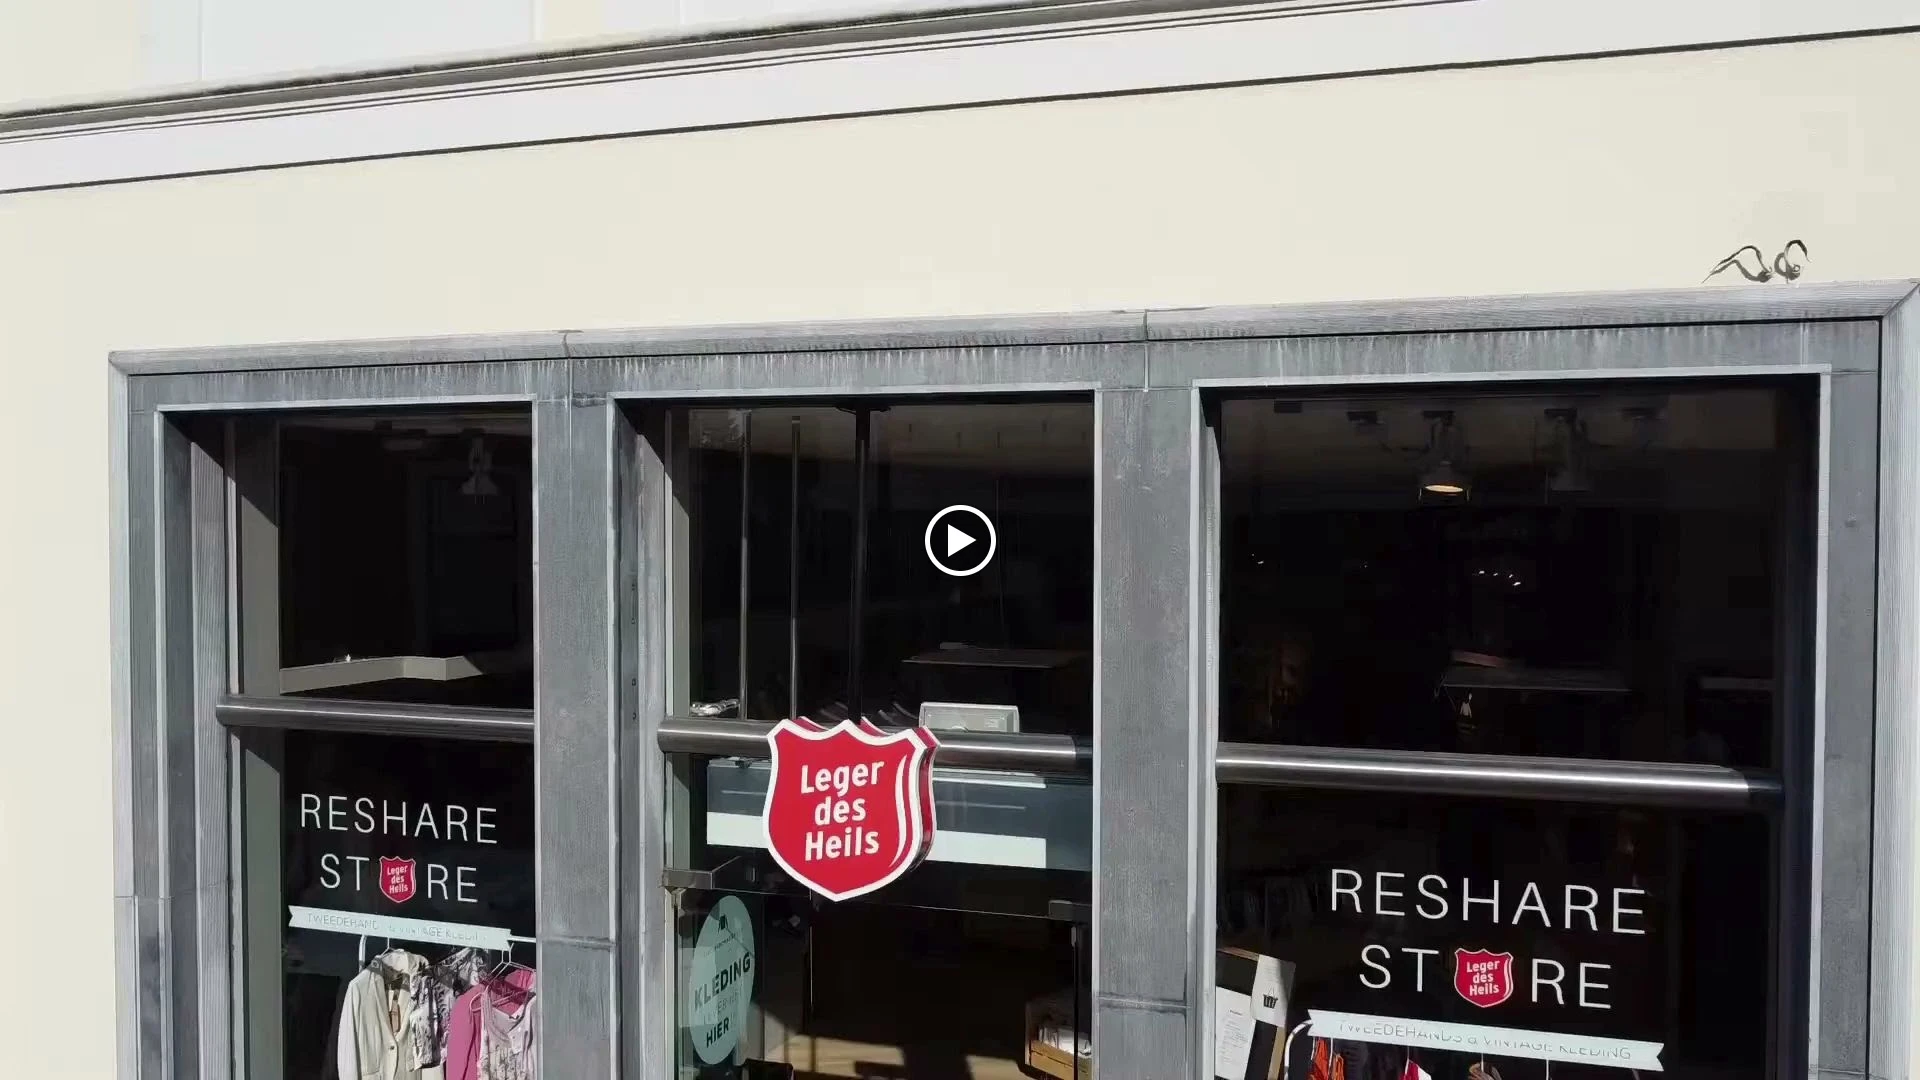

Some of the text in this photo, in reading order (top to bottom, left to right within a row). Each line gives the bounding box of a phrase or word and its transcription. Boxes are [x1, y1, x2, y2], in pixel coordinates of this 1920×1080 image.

[800, 761, 885, 798] Leger
[301, 793, 498, 844] RESHARE
[814, 795, 866, 826] des
[804, 826, 880, 862] Heils
[387, 865, 409, 876] Leger
[391, 875, 405, 885] des
[389, 883, 409, 894] Heils
[1330, 868, 1646, 935] RESHARE
[307, 912, 380, 930] TWEEDEHAND
[1466, 960, 1500, 974] Leger
[1472, 972, 1494, 984] des
[694, 951, 751, 1010] KLEDING
[1469, 983, 1500, 996] Heils
[706, 1016, 730, 1048] HIER
